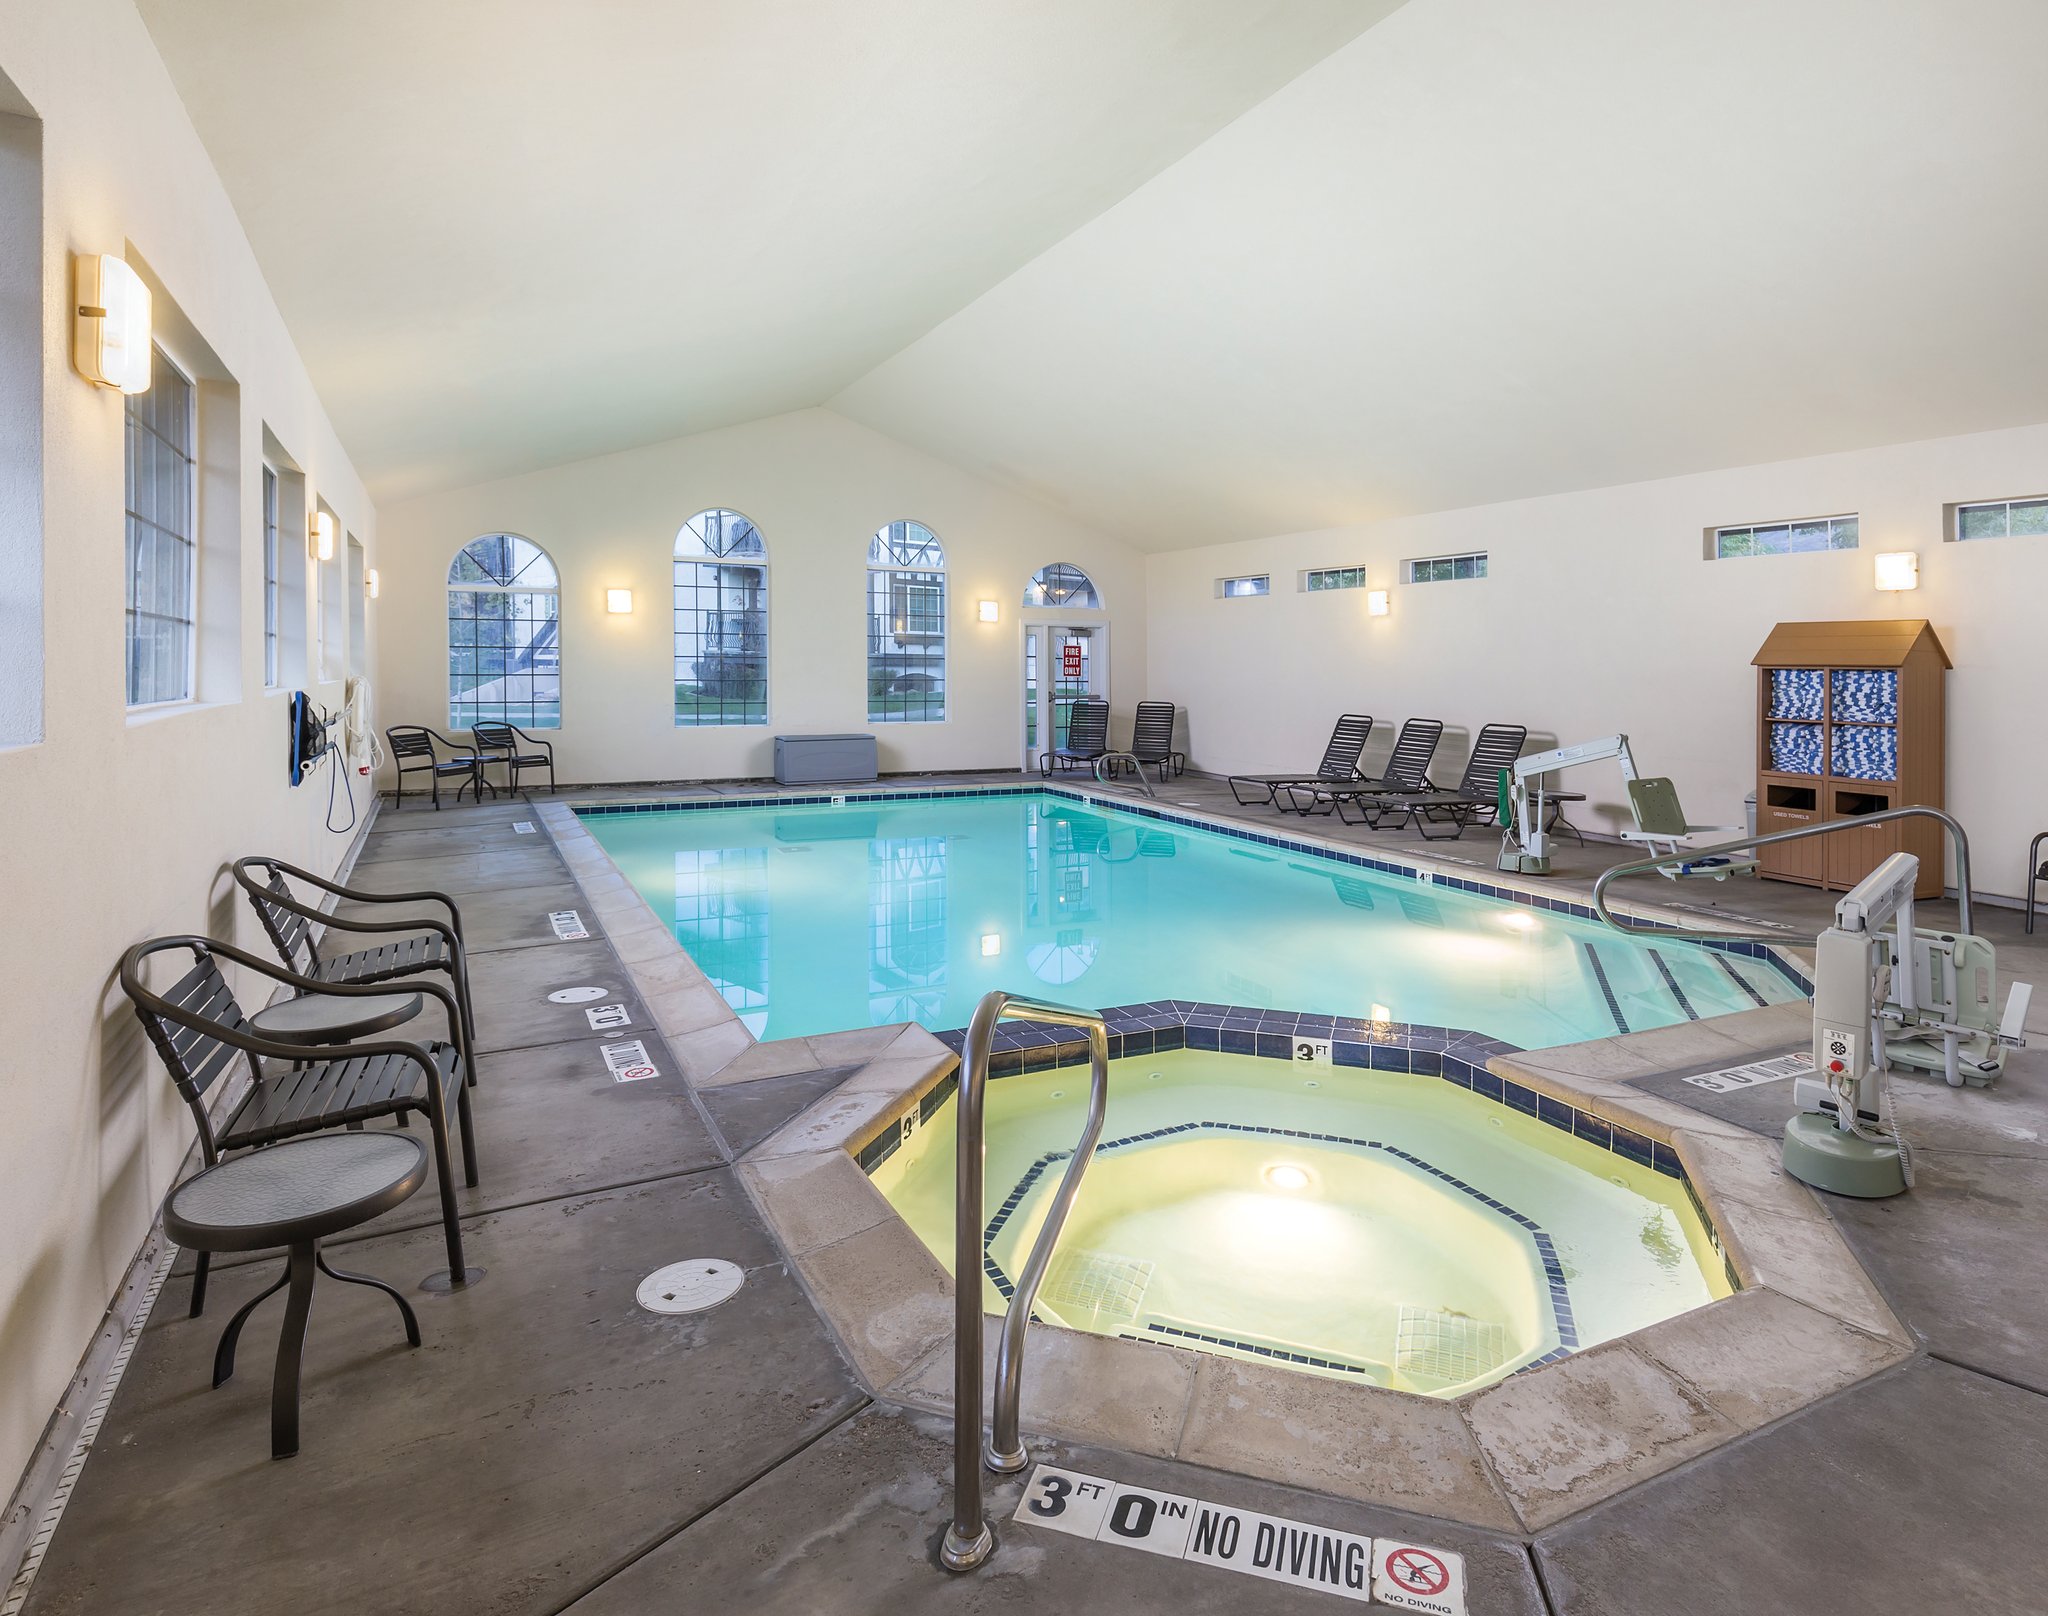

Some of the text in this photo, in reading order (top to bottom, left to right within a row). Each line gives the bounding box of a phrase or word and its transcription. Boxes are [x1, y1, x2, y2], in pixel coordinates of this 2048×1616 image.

[1065, 647, 1079, 655] FIRE
[1065, 657, 1079, 665] EXIT
[1064, 667, 1080, 675] ONLY
[592, 1005, 619, 1013] 3
[1297, 1043, 1328, 1060] 3 FT
[1692, 1078, 1725, 1089] 3
[1718, 1072, 1753, 1083] 0
[903, 1116, 912, 1139] 3
[1028, 1475, 1365, 1590] 3 FT 0 IN NO DIVING
[1384, 1592, 1452, 1614] NO DIVING
